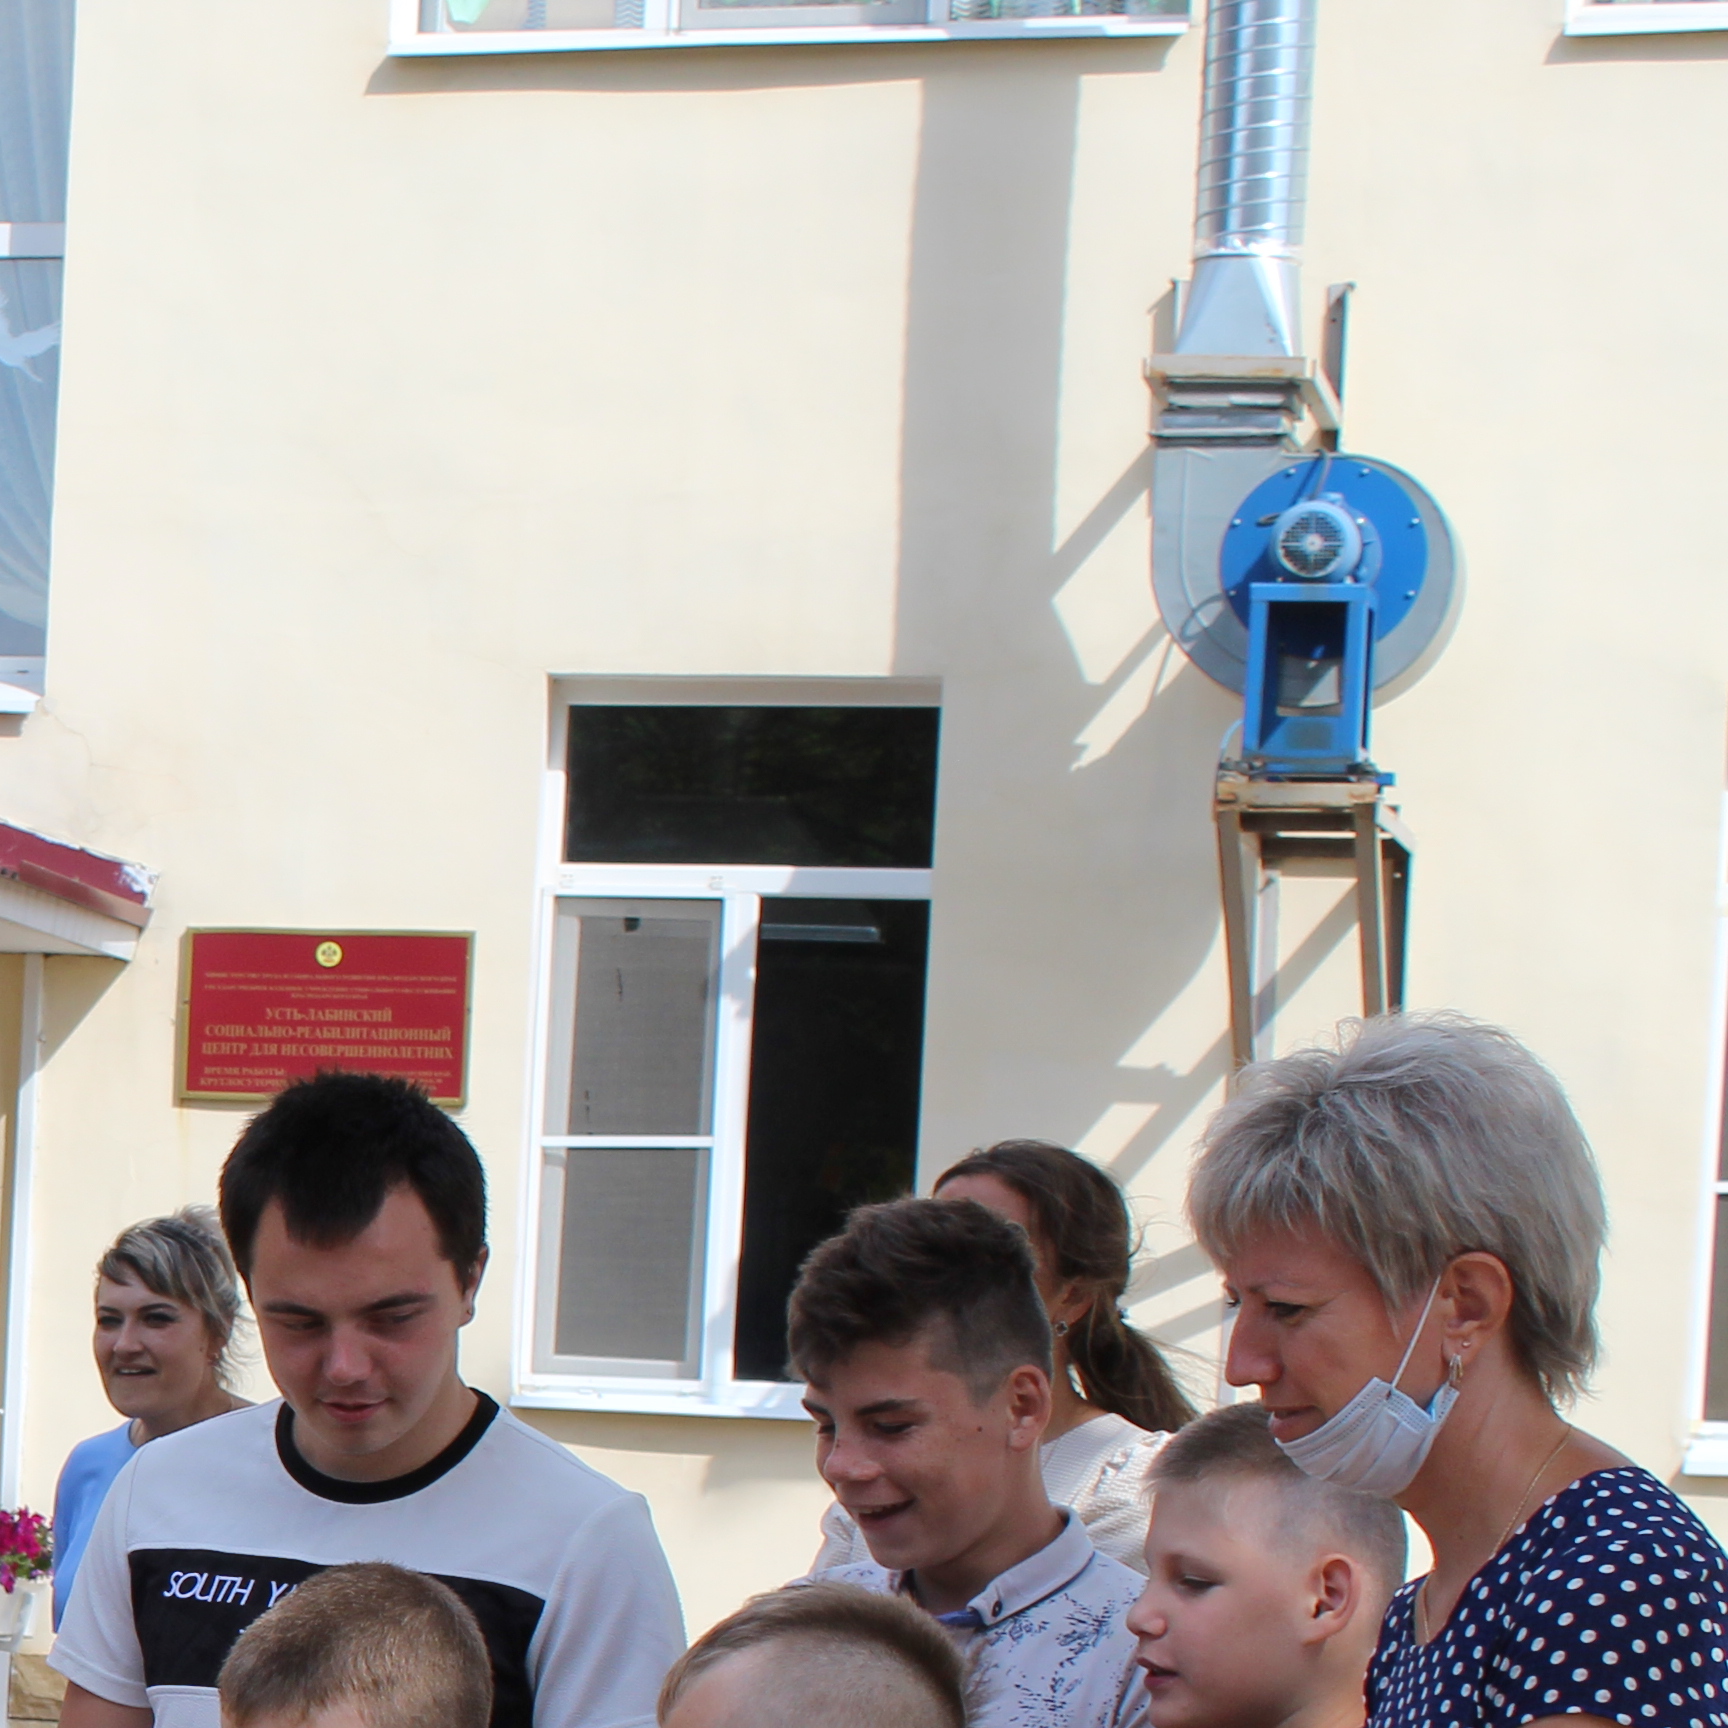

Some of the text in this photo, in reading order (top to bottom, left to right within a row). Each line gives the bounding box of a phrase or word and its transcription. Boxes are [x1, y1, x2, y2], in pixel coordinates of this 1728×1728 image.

[266, 1007, 392, 1022] УСТЬ-ЛАБИНСКИЙ
[205, 1024, 451, 1041] СОЦИАЛЬНО-РЕАБИЛИТАЦИОННЫЙ
[202, 1042, 454, 1059] ЦЕНТР ДЛЯ НЕСОВЕРШЕННОЛЕТНИХ
[163, 1571, 256, 1606] SOUTH
